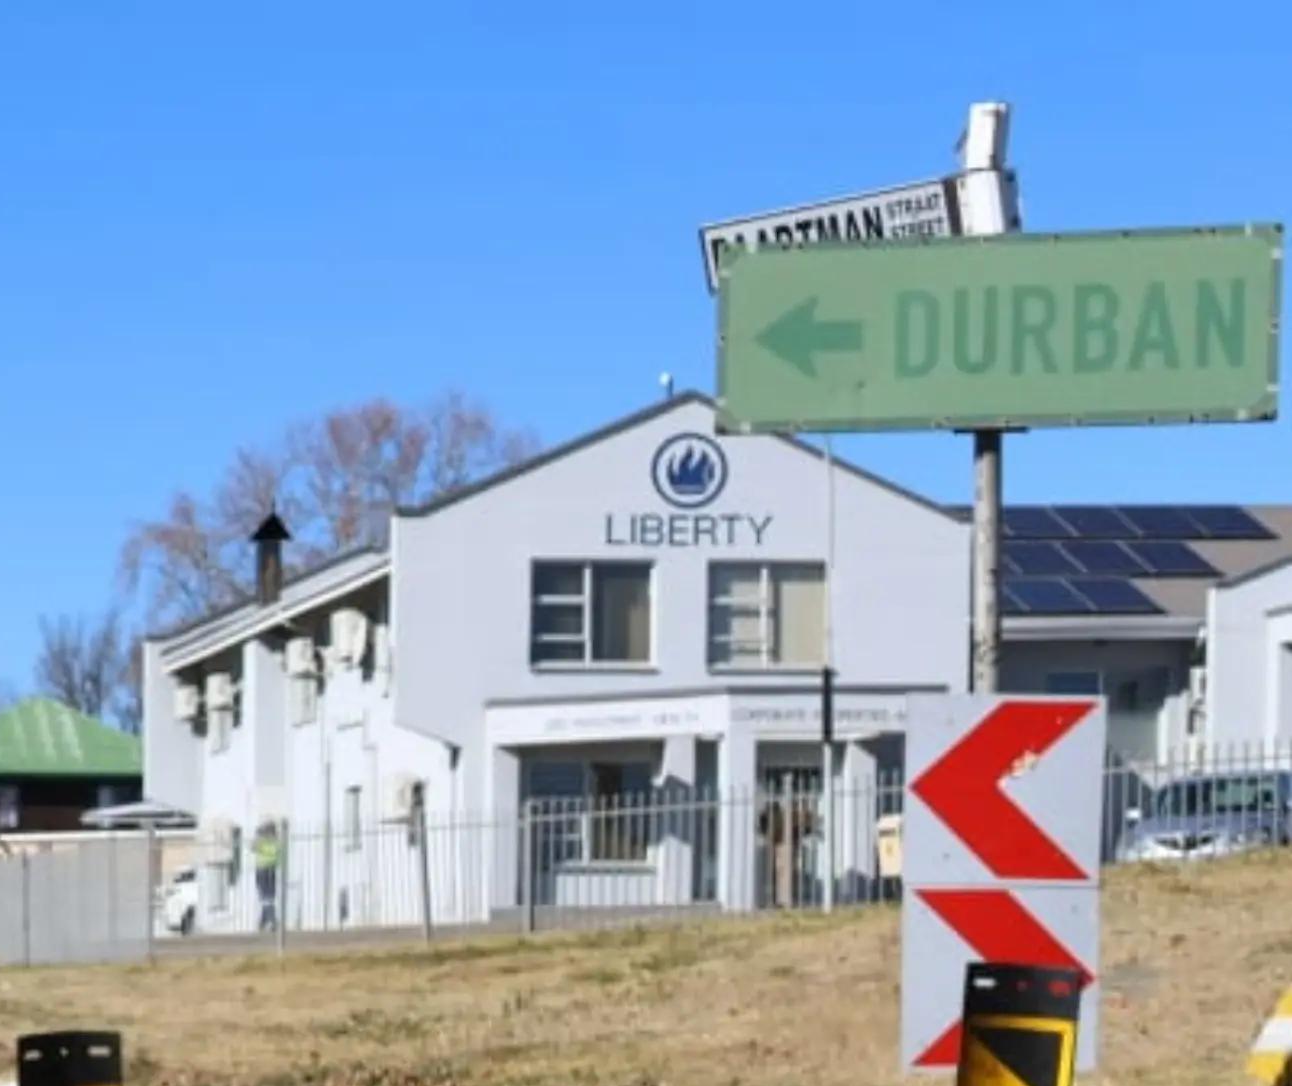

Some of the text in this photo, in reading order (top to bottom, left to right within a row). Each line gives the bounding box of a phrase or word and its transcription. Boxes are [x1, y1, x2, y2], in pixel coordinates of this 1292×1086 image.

[711, 193, 941, 262] RTMAN STRAAT
[891, 217, 945, 239] STREET
[893, 278, 1247, 379] DURBAN
[605, 514, 773, 546] LIBERTY
